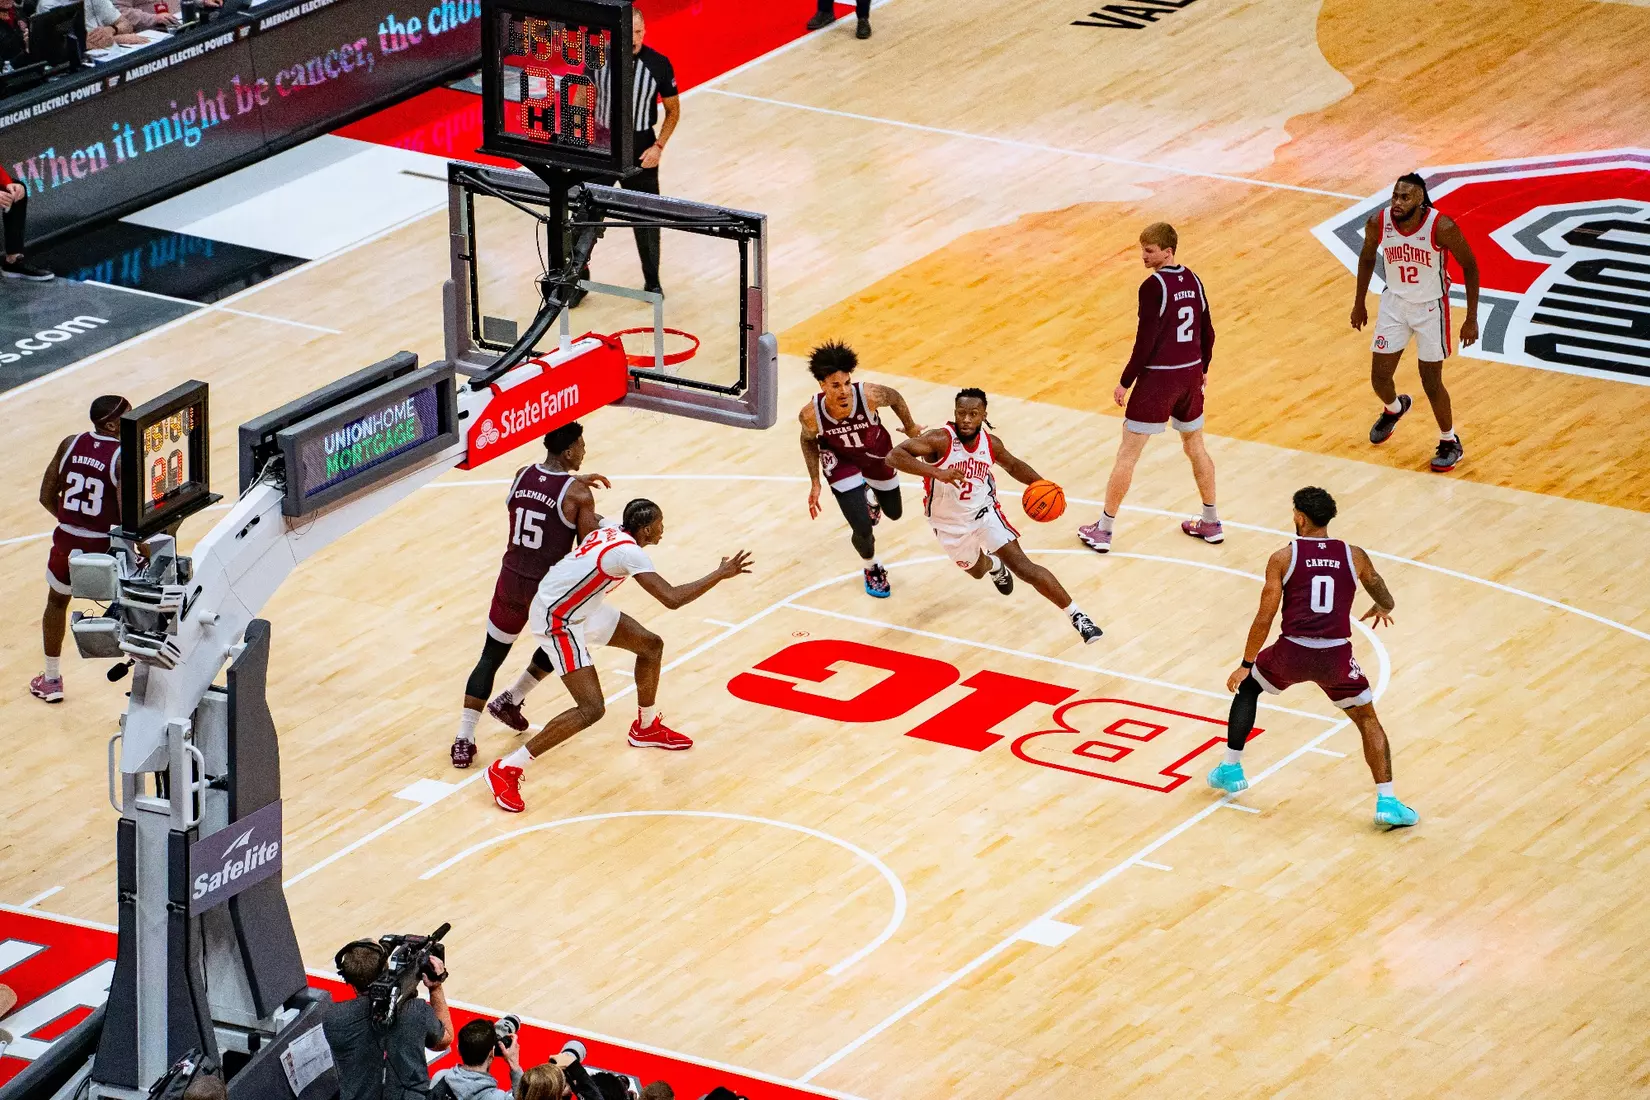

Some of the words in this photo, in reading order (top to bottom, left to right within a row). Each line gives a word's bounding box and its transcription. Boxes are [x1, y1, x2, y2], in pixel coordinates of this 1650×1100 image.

[259, 6, 300, 31] AMERICAN
[125, 56, 168, 82] AMERICAN
[169, 43, 204, 65] ELECTRIC
[204, 31, 235, 52] POWER
[13, 147, 109, 197] When
[112, 121, 138, 163] it
[142, 88, 231, 153] might
[231, 75, 270, 115] be
[274, 37, 375, 97] cancer,
[378, 14, 423, 55] the
[32, 94, 70, 116] ELECTRIC
[70, 81, 103, 102] POWER
[1398, 265, 1419, 284] 12
[1176, 305, 1194, 343] 2
[325, 416, 416, 480] MORTGAGE
[826, 425, 852, 436] TEXAS
[839, 431, 864, 448] 11
[72, 455, 106, 471] RADFORD
[63, 471, 104, 517] 23
[515, 489, 548, 503] COLEMAN
[545, 497, 557, 509] III
[959, 481, 973, 500] 2
[512, 506, 547, 550] 15
[1305, 558, 1340, 570] CARTER
[1310, 574, 1335, 614] 0
[192, 841, 279, 900] Safelite
